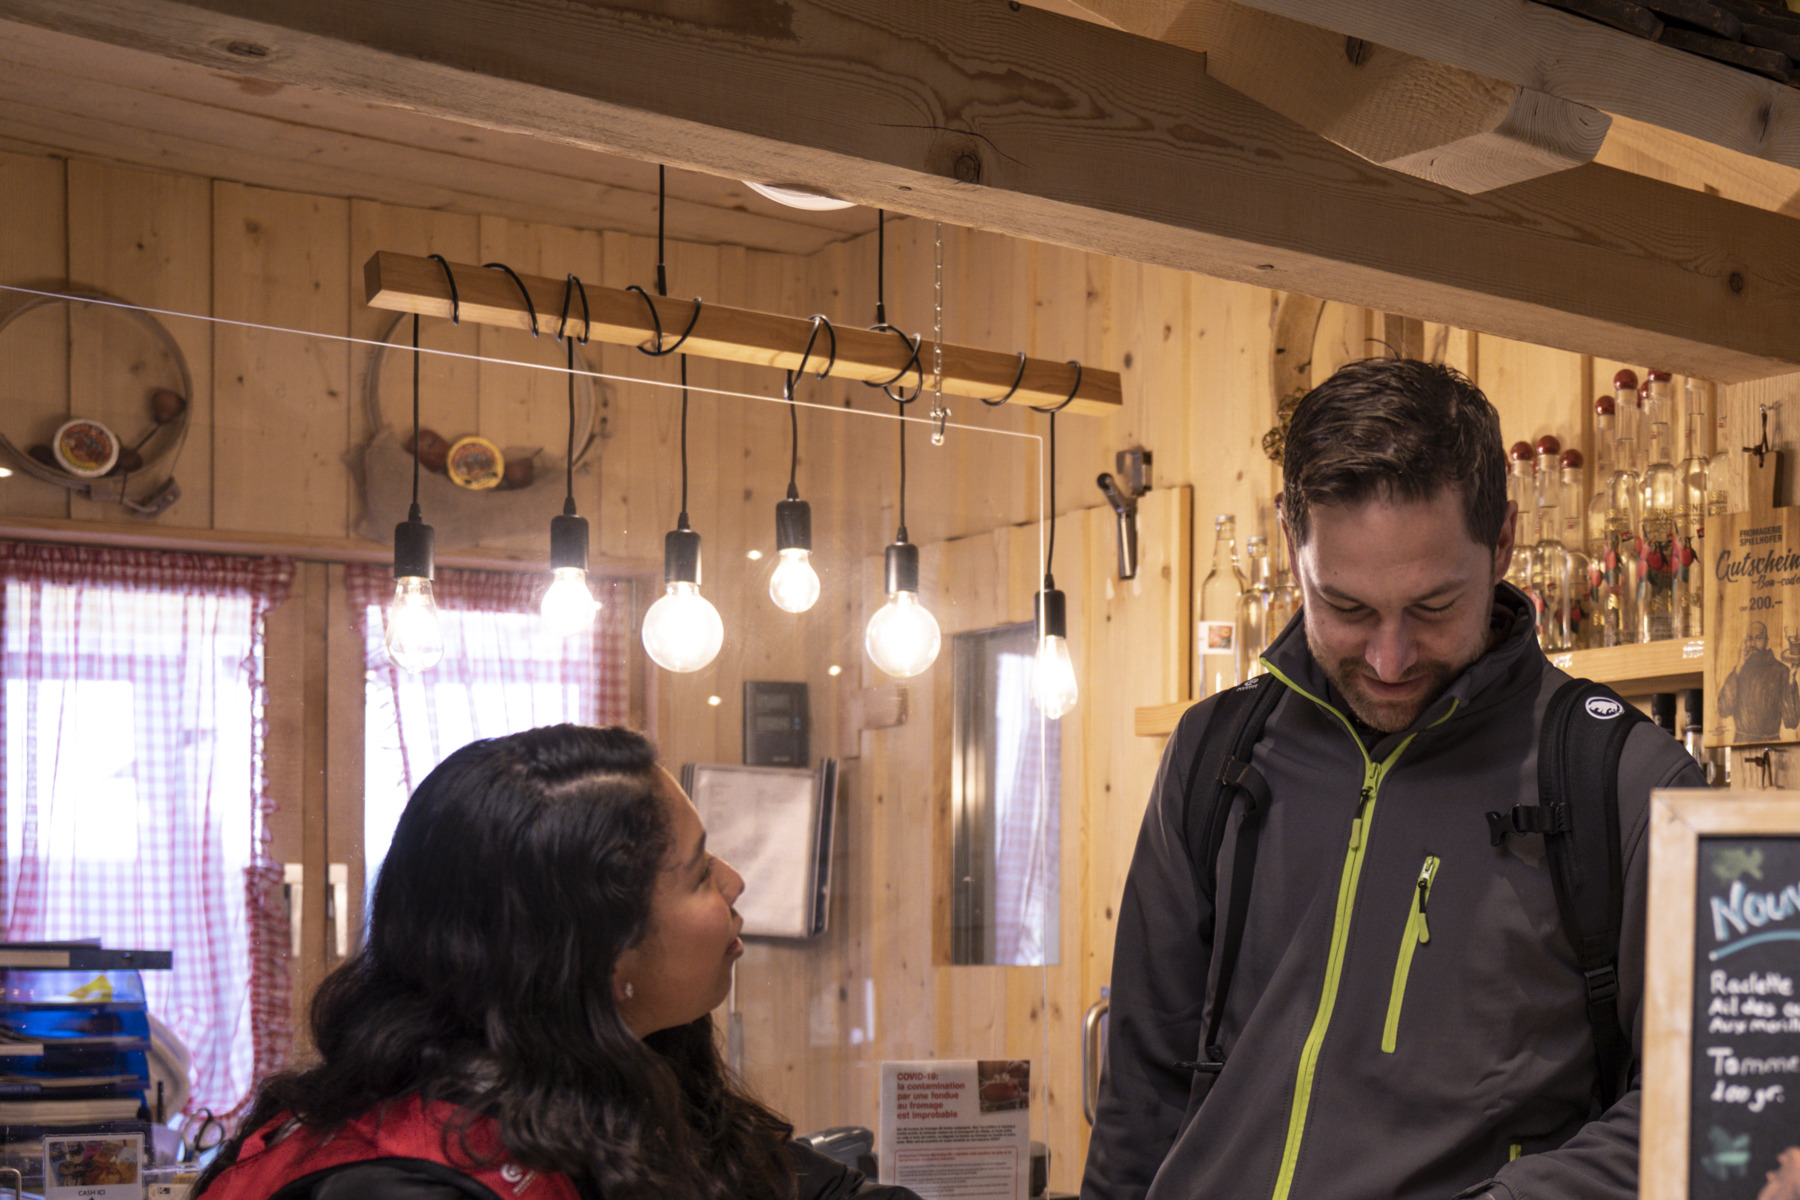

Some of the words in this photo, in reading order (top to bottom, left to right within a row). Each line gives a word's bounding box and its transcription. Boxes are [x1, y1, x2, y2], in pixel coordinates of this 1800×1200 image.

[1740, 525, 1782, 537] FROMAGERIE
[1740, 534, 1782, 547] SPIELHOFER
[1710, 970, 1794, 996] Raclette
[1706, 1046, 1800, 1077] Tomme
[896, 1072, 939, 1081] COVID-19:
[897, 1082, 905, 1090] la
[907, 1082, 965, 1090] contamination
[897, 1092, 910, 1101] par
[931, 1091, 959, 1100] fondue
[909, 1101, 944, 1111] fromage
[912, 1110, 958, 1120] improbable
[78, 1189, 96, 1197] CASH
